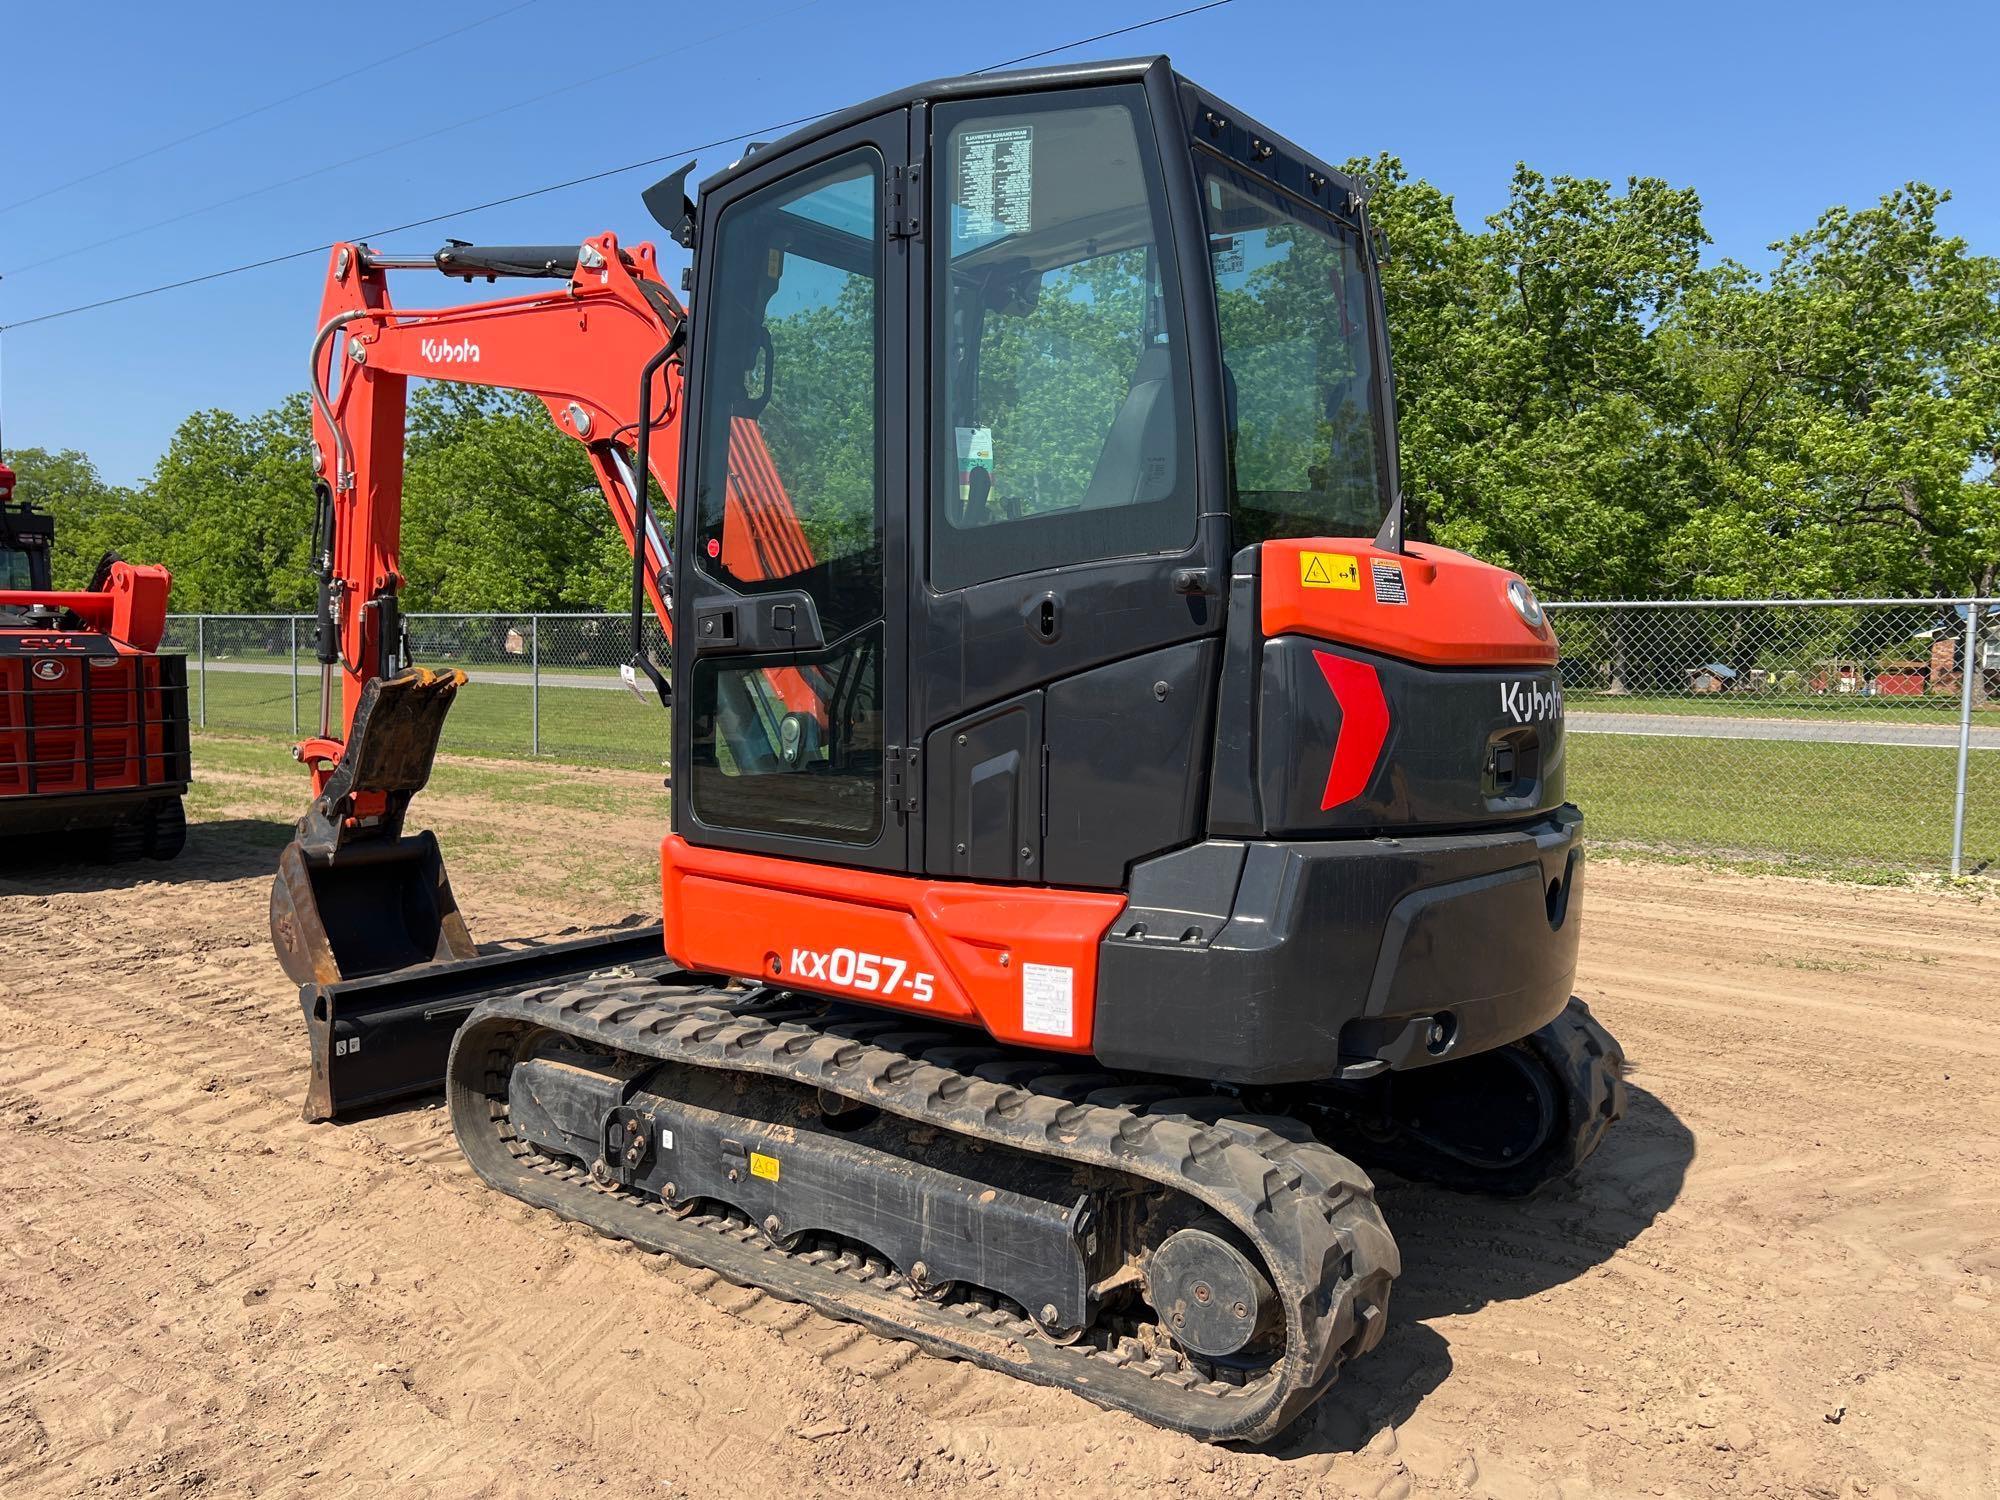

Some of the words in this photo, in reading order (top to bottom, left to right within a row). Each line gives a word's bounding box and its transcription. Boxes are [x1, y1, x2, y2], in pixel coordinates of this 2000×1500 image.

[421, 338, 480, 363] Kubota
[19, 638, 86, 650] SVL
[1500, 680, 1562, 723] Kubota
[790, 947, 935, 1003] KX057-5
